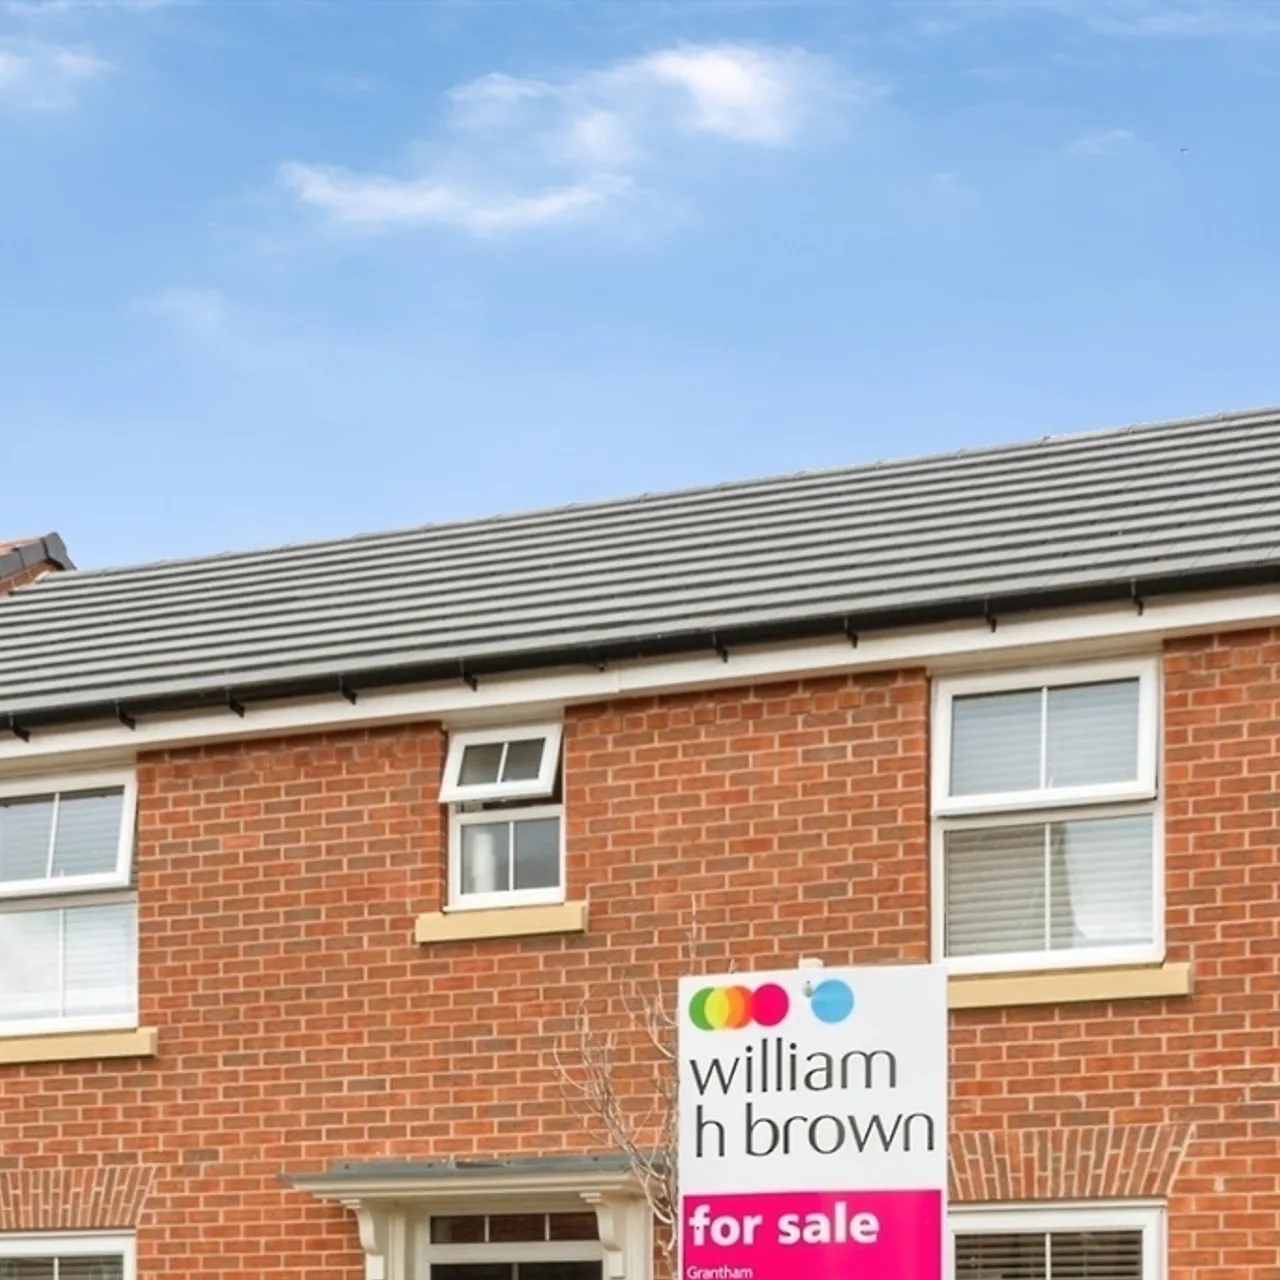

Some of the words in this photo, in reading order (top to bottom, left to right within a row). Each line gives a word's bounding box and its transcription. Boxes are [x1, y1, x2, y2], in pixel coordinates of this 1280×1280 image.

[689, 1037, 897, 1096] william
[696, 1104, 725, 1158] h
[745, 1102, 935, 1157] brown
[688, 1204, 763, 1246] for
[777, 1201, 880, 1245] sale
[686, 1265, 754, 1280] Grantham
